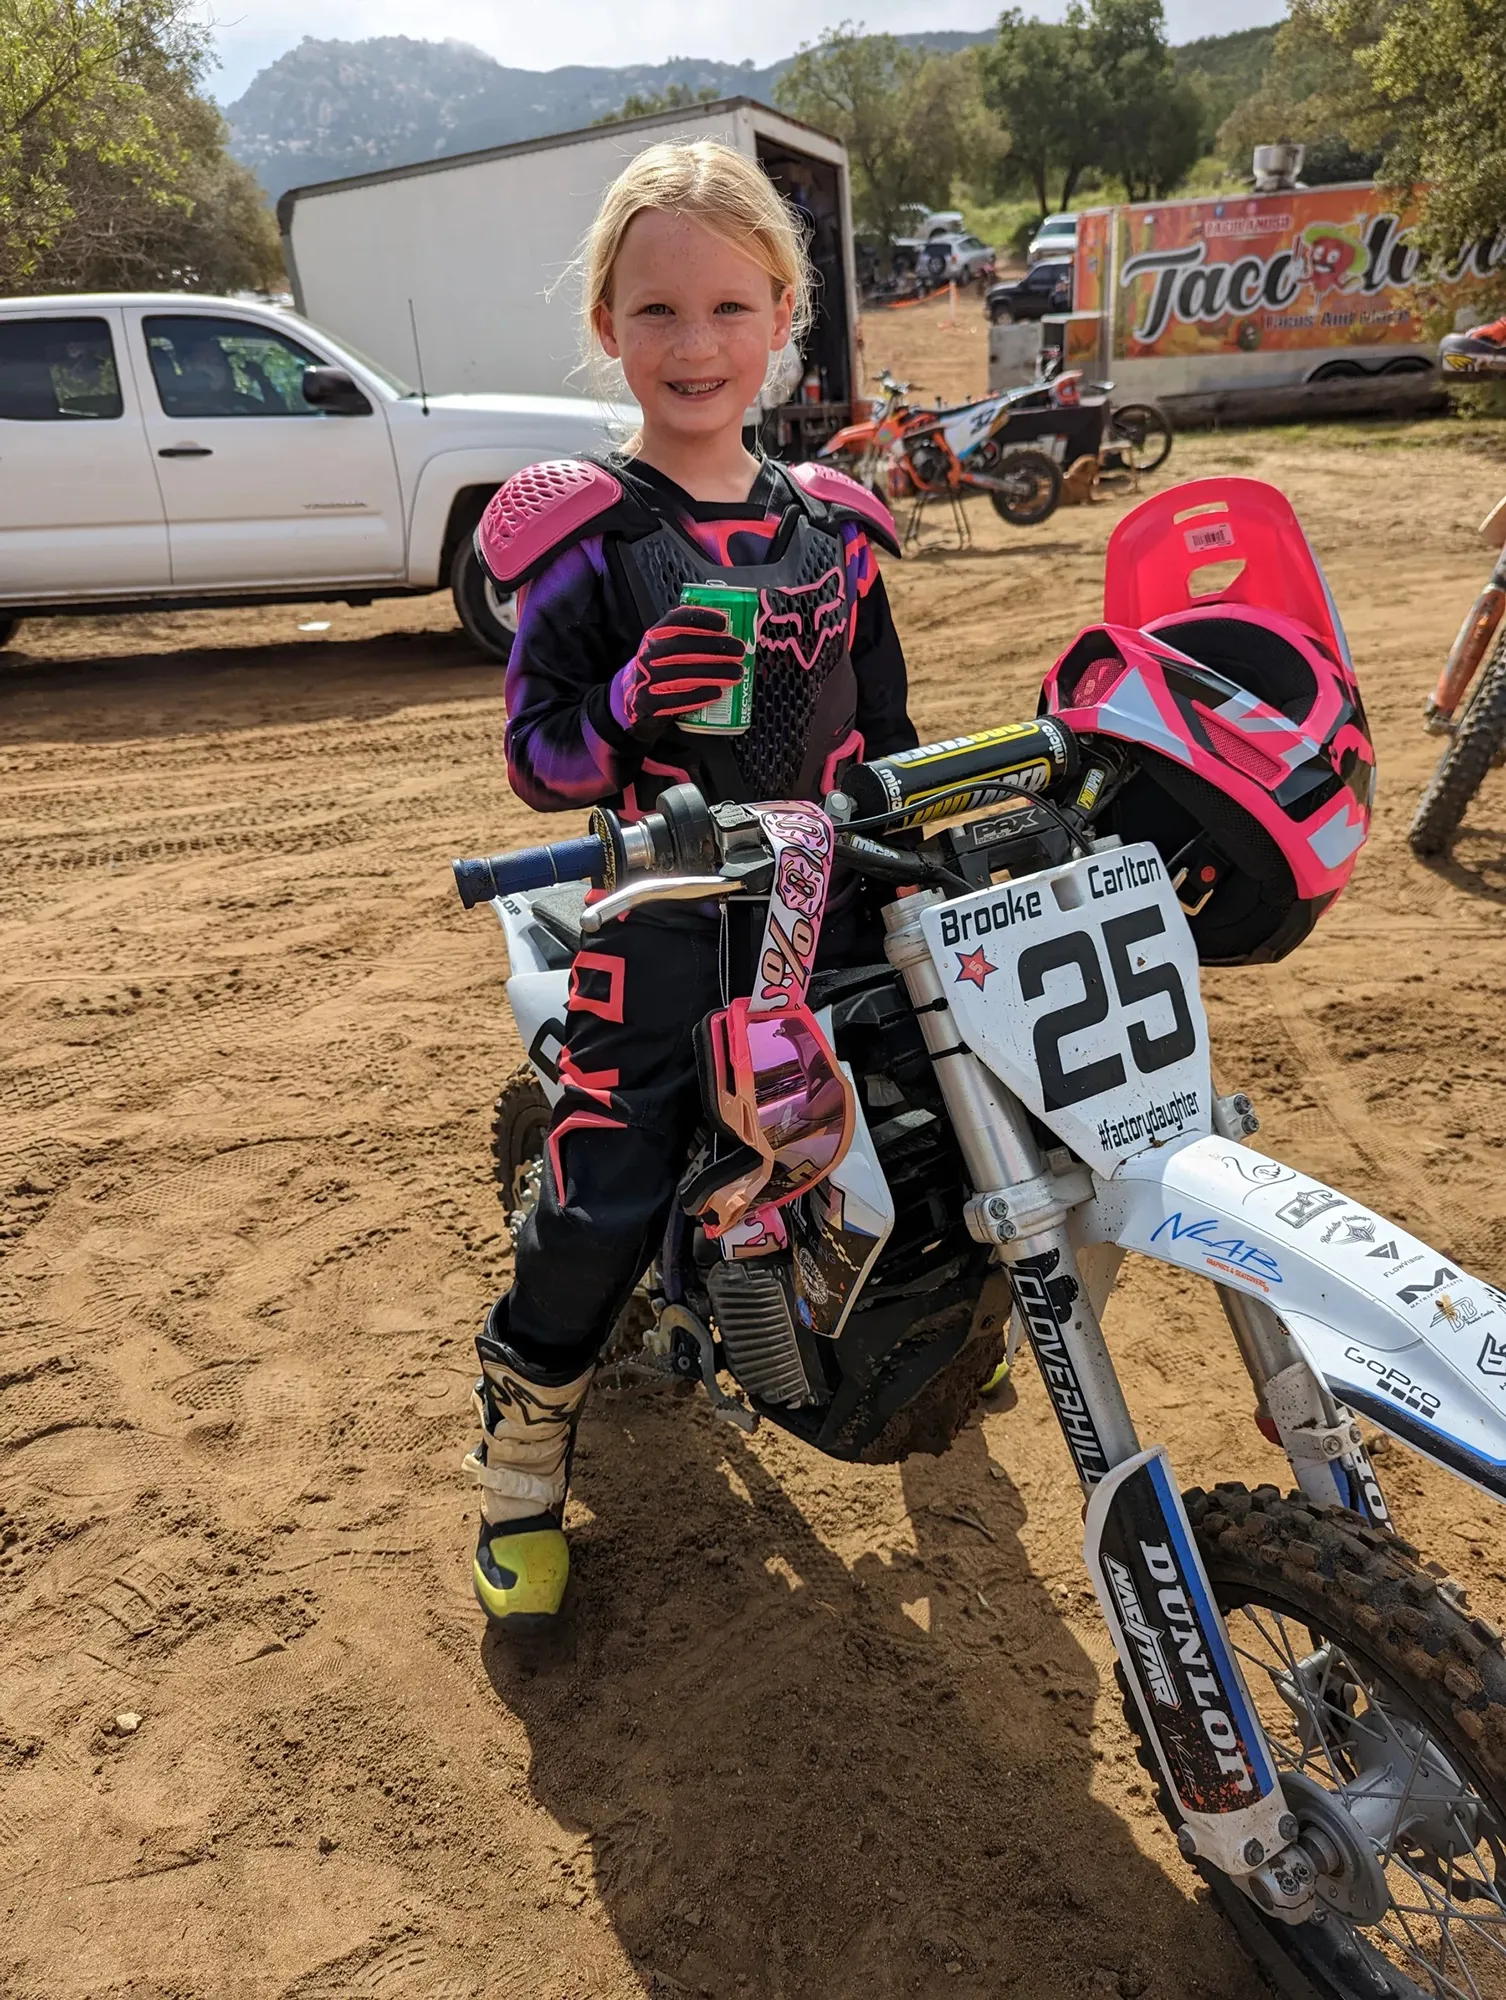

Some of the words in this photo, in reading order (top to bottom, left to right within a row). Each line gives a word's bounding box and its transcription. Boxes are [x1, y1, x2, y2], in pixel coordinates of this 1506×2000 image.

[740, 666, 751, 724] RECYCLE
[879, 768, 903, 811] micro
[940, 889, 1042, 947] Brooke
[1088, 855, 1164, 900] Carlton
[1017, 904, 1197, 1113] 25
[1097, 1089, 1200, 1152] #factorydaughter
[1206, 1257, 1230, 1272] GRAPHICS
[1410, 1293, 1434, 1309] MATRIX
[1013, 1273, 1110, 1484] CLOVERHILL
[1344, 1347, 1441, 1409] GoPro
[1139, 1540, 1253, 1792] DUNLOP
